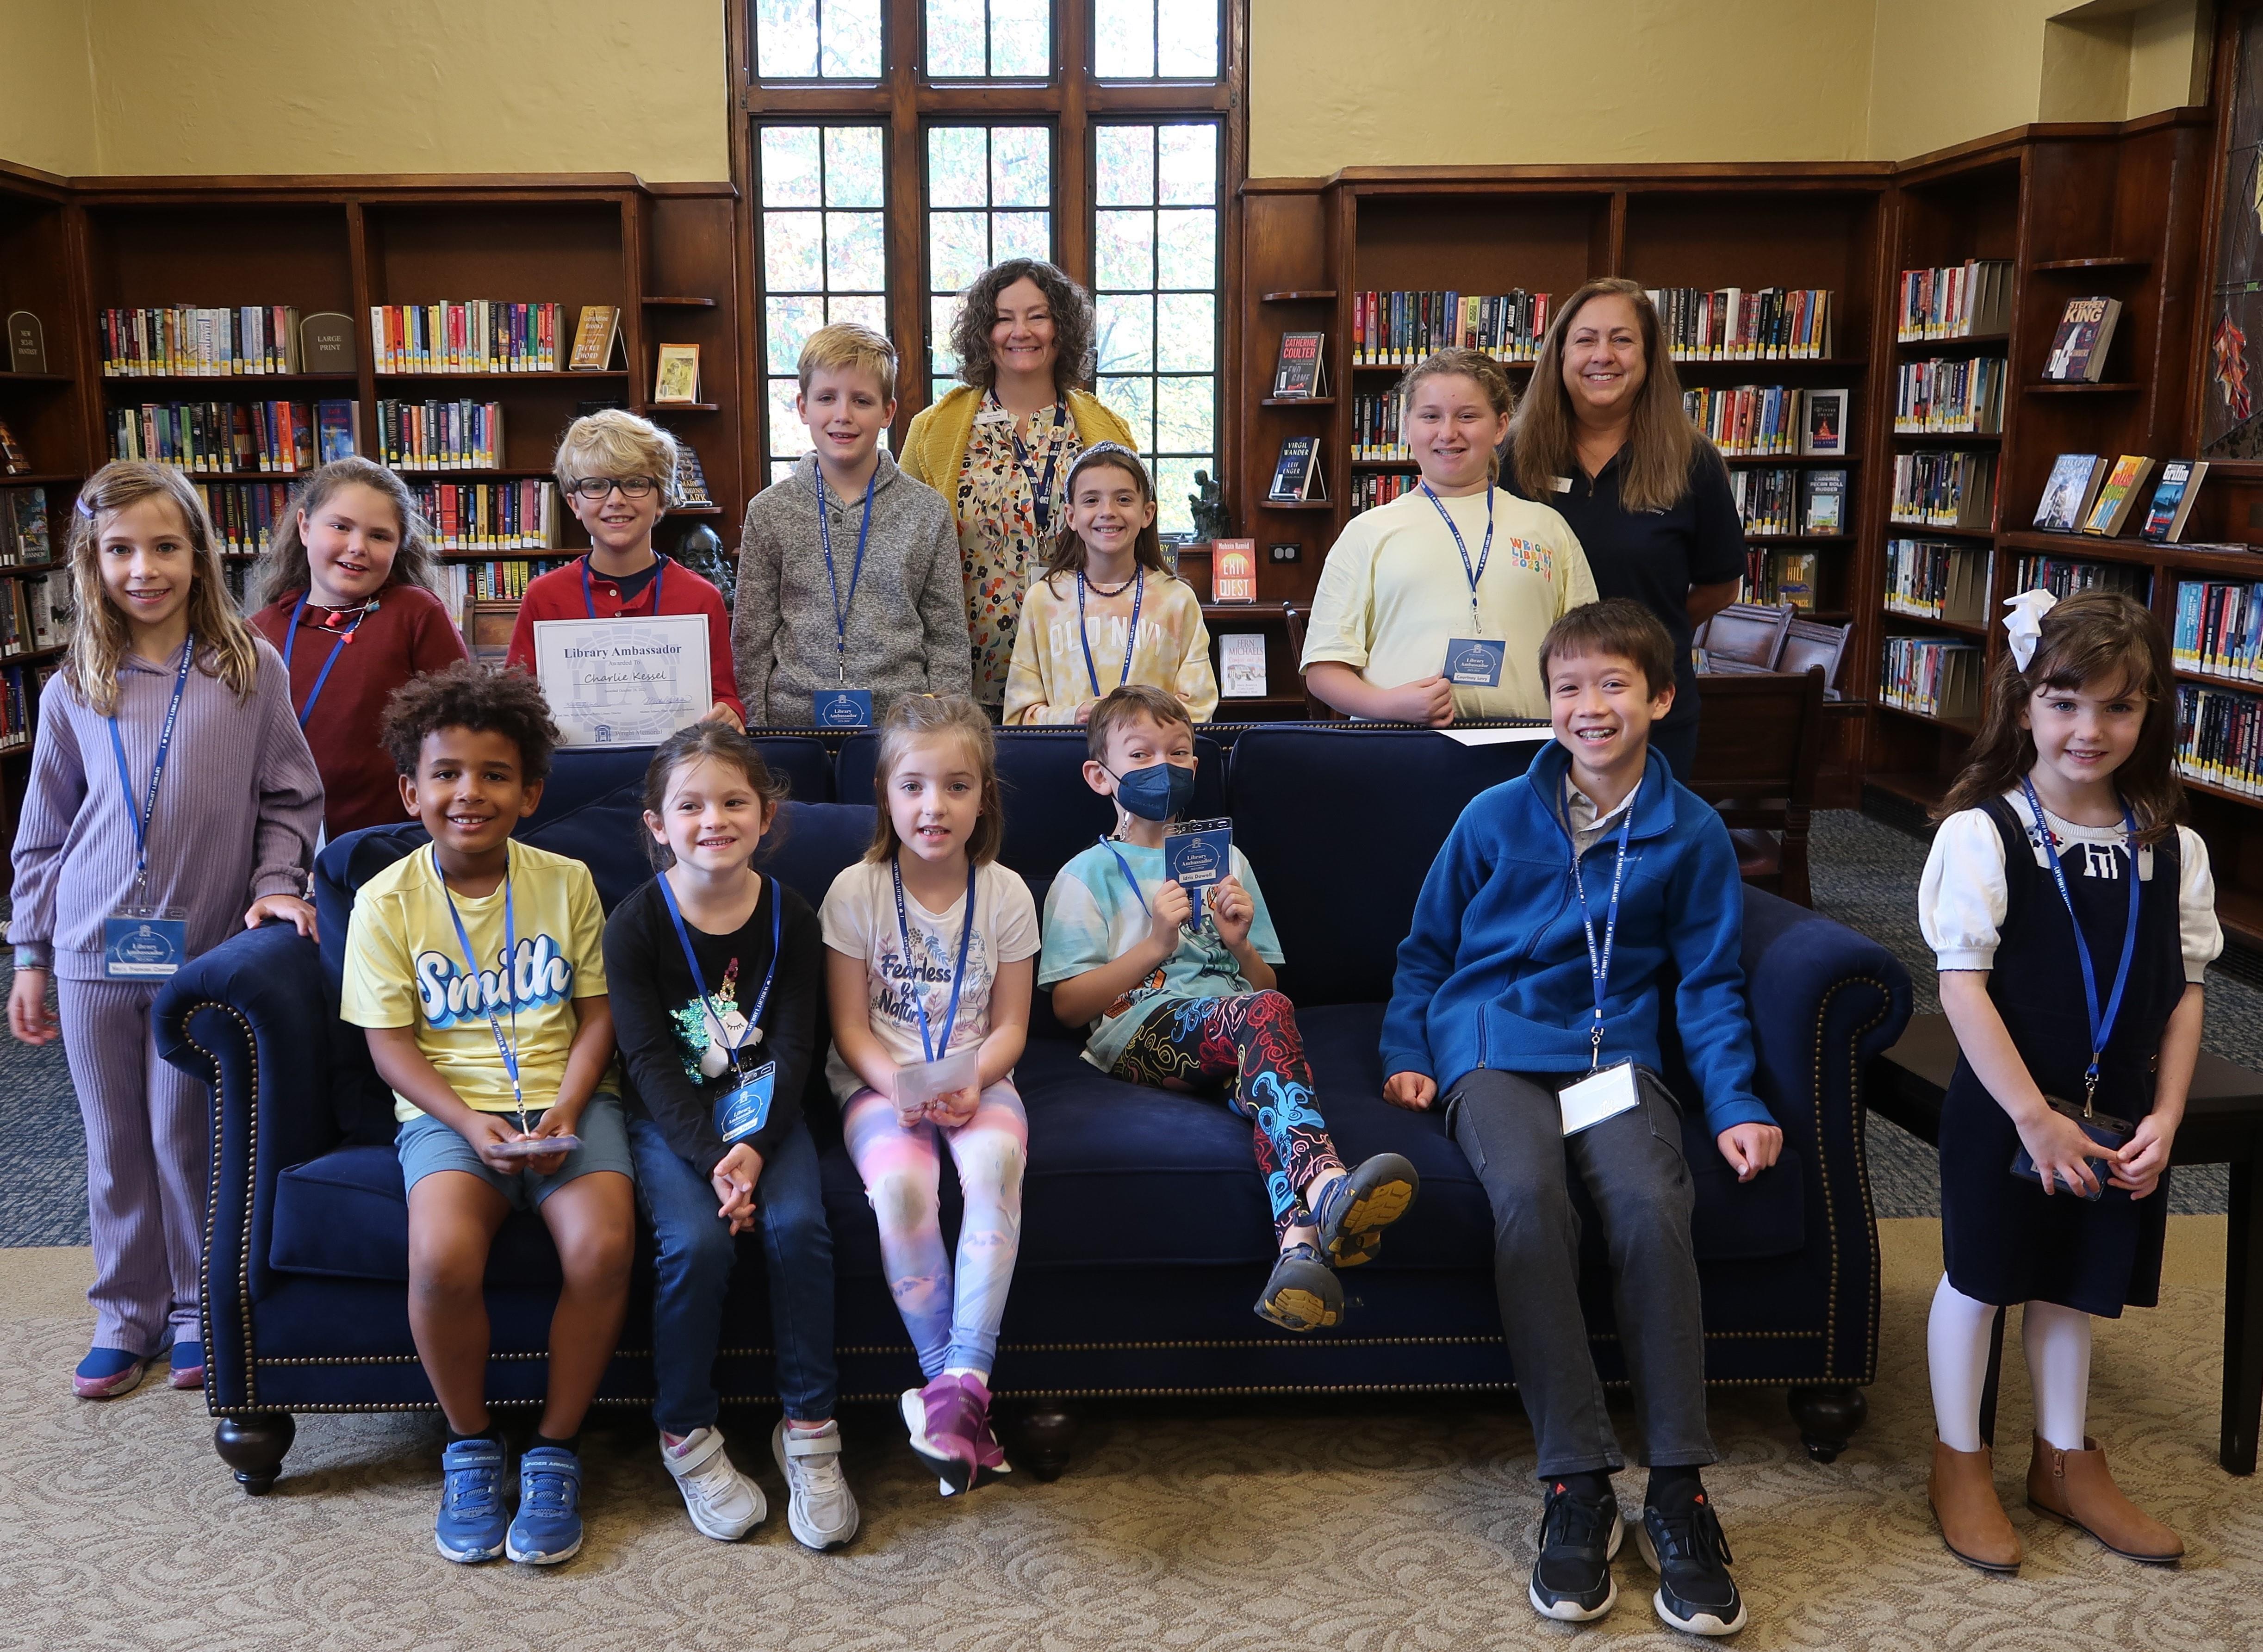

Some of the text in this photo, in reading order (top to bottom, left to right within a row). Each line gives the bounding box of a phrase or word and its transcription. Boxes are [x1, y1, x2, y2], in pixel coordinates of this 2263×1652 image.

[2063, 308, 2102, 323] KING
[2069, 300, 2106, 310] STEPHEN
[1283, 348, 1316, 358] COULTER
[1285, 338, 1318, 348] CATHERINE
[1292, 373, 1311, 382] GAME
[386, 401, 398, 441] SANDRA BROWN
[2163, 464, 2189, 481] Griffin
[1510, 537, 1552, 560] WRIGHT
[1511, 547, 1552, 569] LIBRARY
[1223, 558, 1245, 575] EXIT
[1462, 552, 1470, 570] LIBRARY
[1050, 616, 1100, 657] OLD
[1237, 639, 1255, 647] FERN
[564, 645, 682, 659] Library Ambassador
[1229, 647, 1264, 655] MICHAELS
[584, 671, 667, 683] Charlie Kessel
[163, 694, 180, 739] WRIGHT LIBRARY
[147, 766, 162, 813] WRIGHT LIBRARY
[2028, 790, 2048, 835] WRIGHT LIBRARY
[1181, 858, 1213, 867] Ambassador
[2053, 865, 2065, 893] LIBRARY
[1612, 880, 1620, 903] LIBRARY
[1585, 921, 1597, 968] WRIGHT LIBRARY
[1601, 933, 1612, 979] WRIGHT LIBRARY
[881, 954, 952, 983] Fearless
[416, 934, 573, 1028] Smith
[900, 981, 918, 1004] By
[748, 986, 769, 1032] WRIGHT LIBRARY
[877, 987, 932, 1024] Nature
[492, 1024, 504, 1046] WRIGHT
[729, 1108, 756, 1124] Ambassador
[734, 1106, 751, 1117] Library
